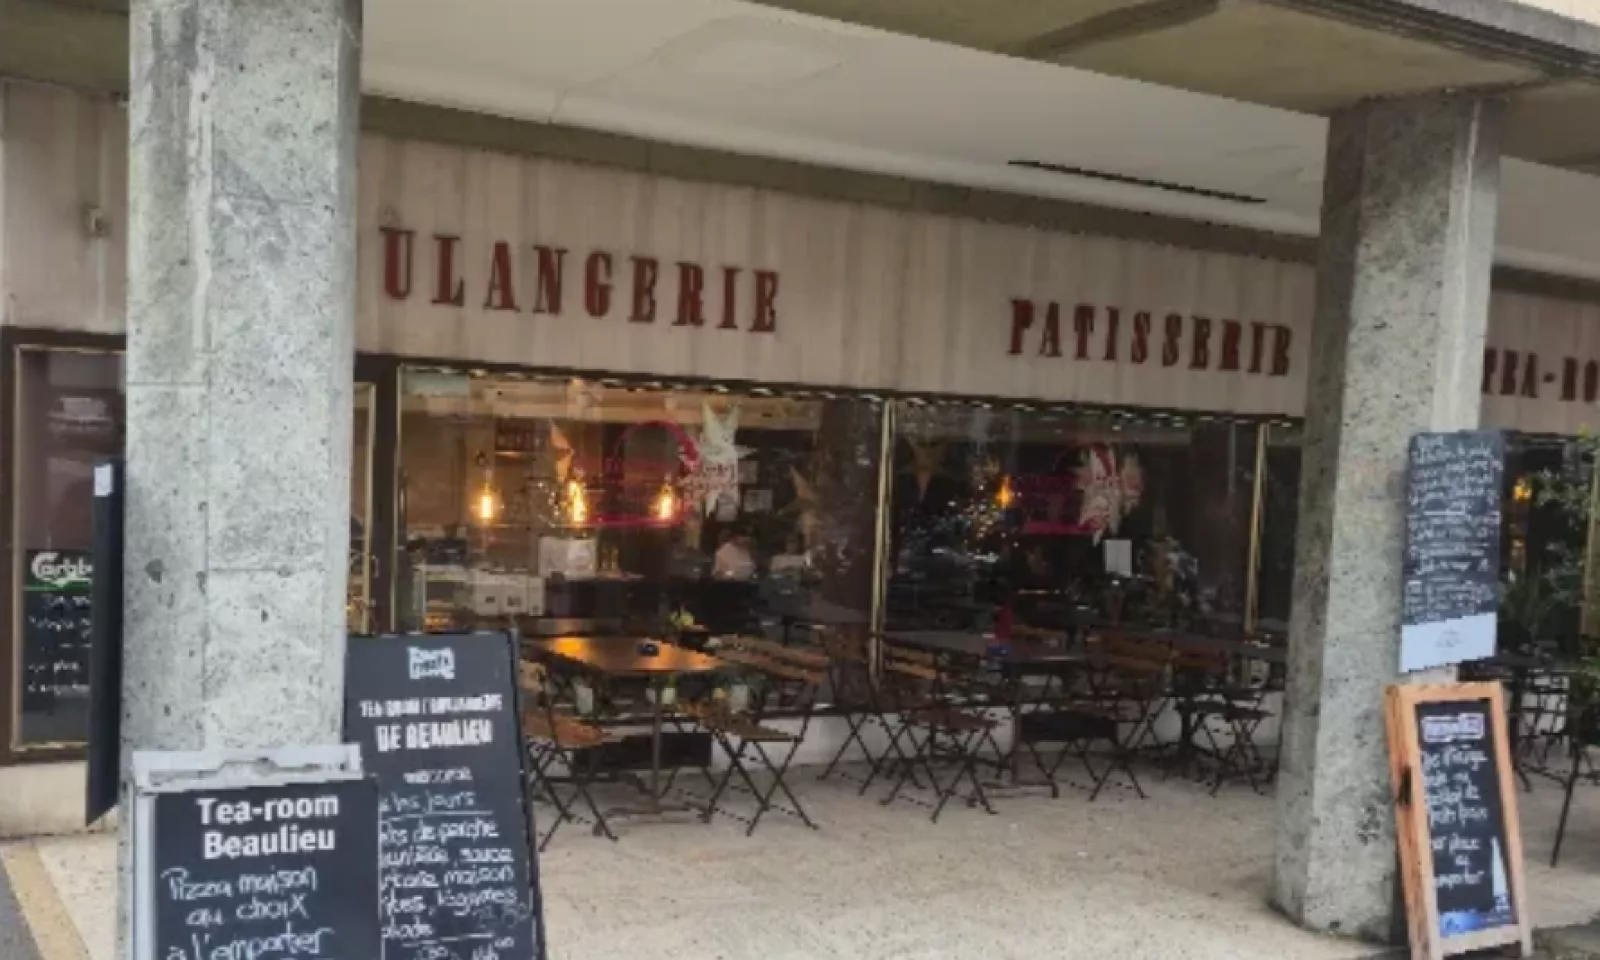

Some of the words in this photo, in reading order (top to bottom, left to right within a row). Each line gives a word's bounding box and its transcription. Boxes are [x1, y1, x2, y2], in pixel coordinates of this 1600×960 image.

[1007, 299, 1292, 377] PATISSERIE
[195, 794, 339, 825] Tea-room
[203, 824, 336, 860] Beaulieu
[160, 867, 233, 901] Pizza
[238, 865, 318, 894] maison
[235, 893, 311, 921] choix
